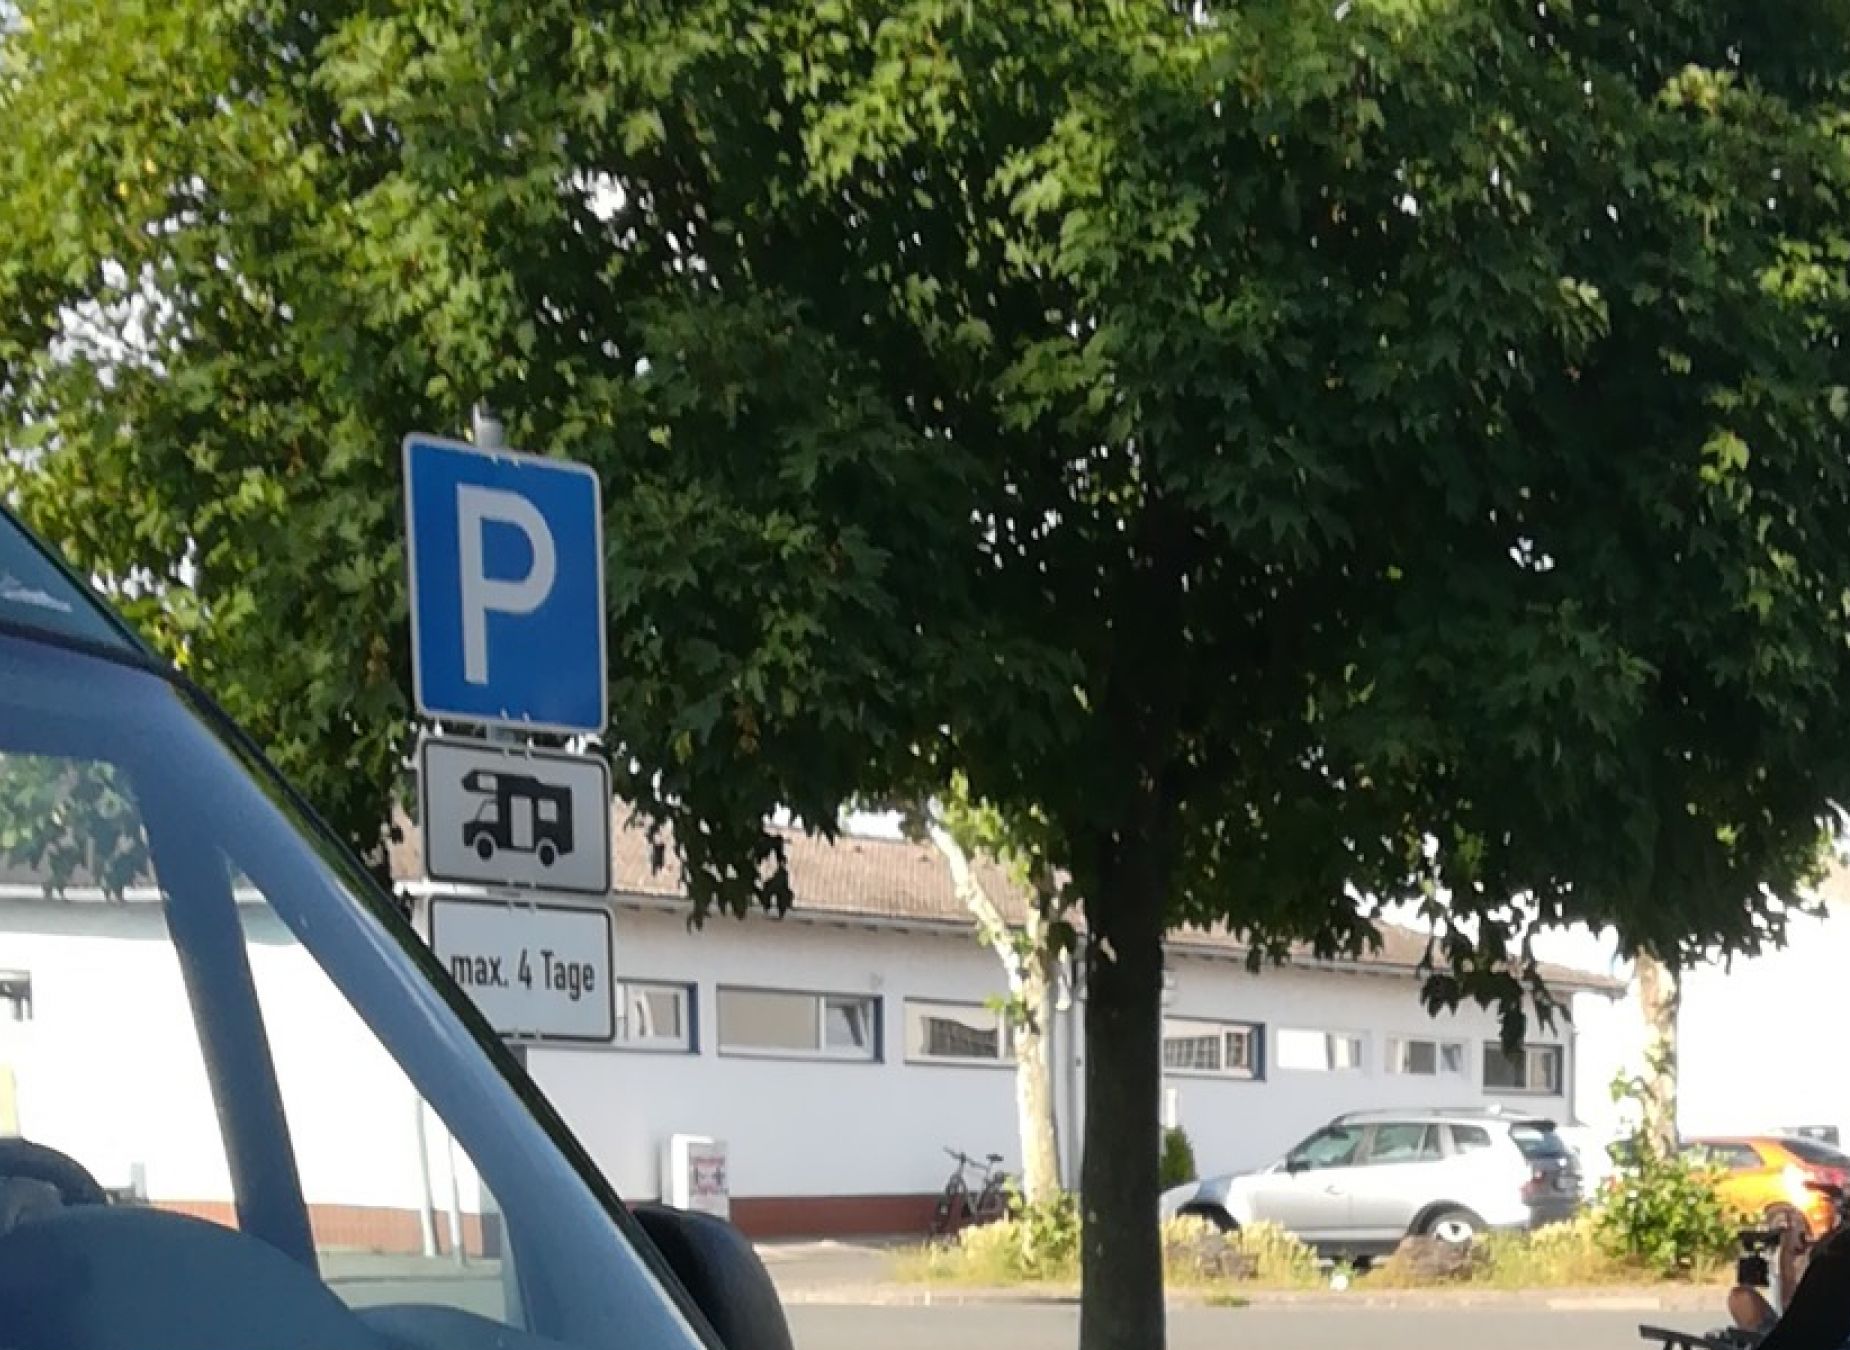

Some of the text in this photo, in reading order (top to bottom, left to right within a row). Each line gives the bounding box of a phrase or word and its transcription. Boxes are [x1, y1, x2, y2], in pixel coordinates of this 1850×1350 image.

[456, 482, 556, 686] P
[451, 948, 595, 1001] max. 4 Tage
